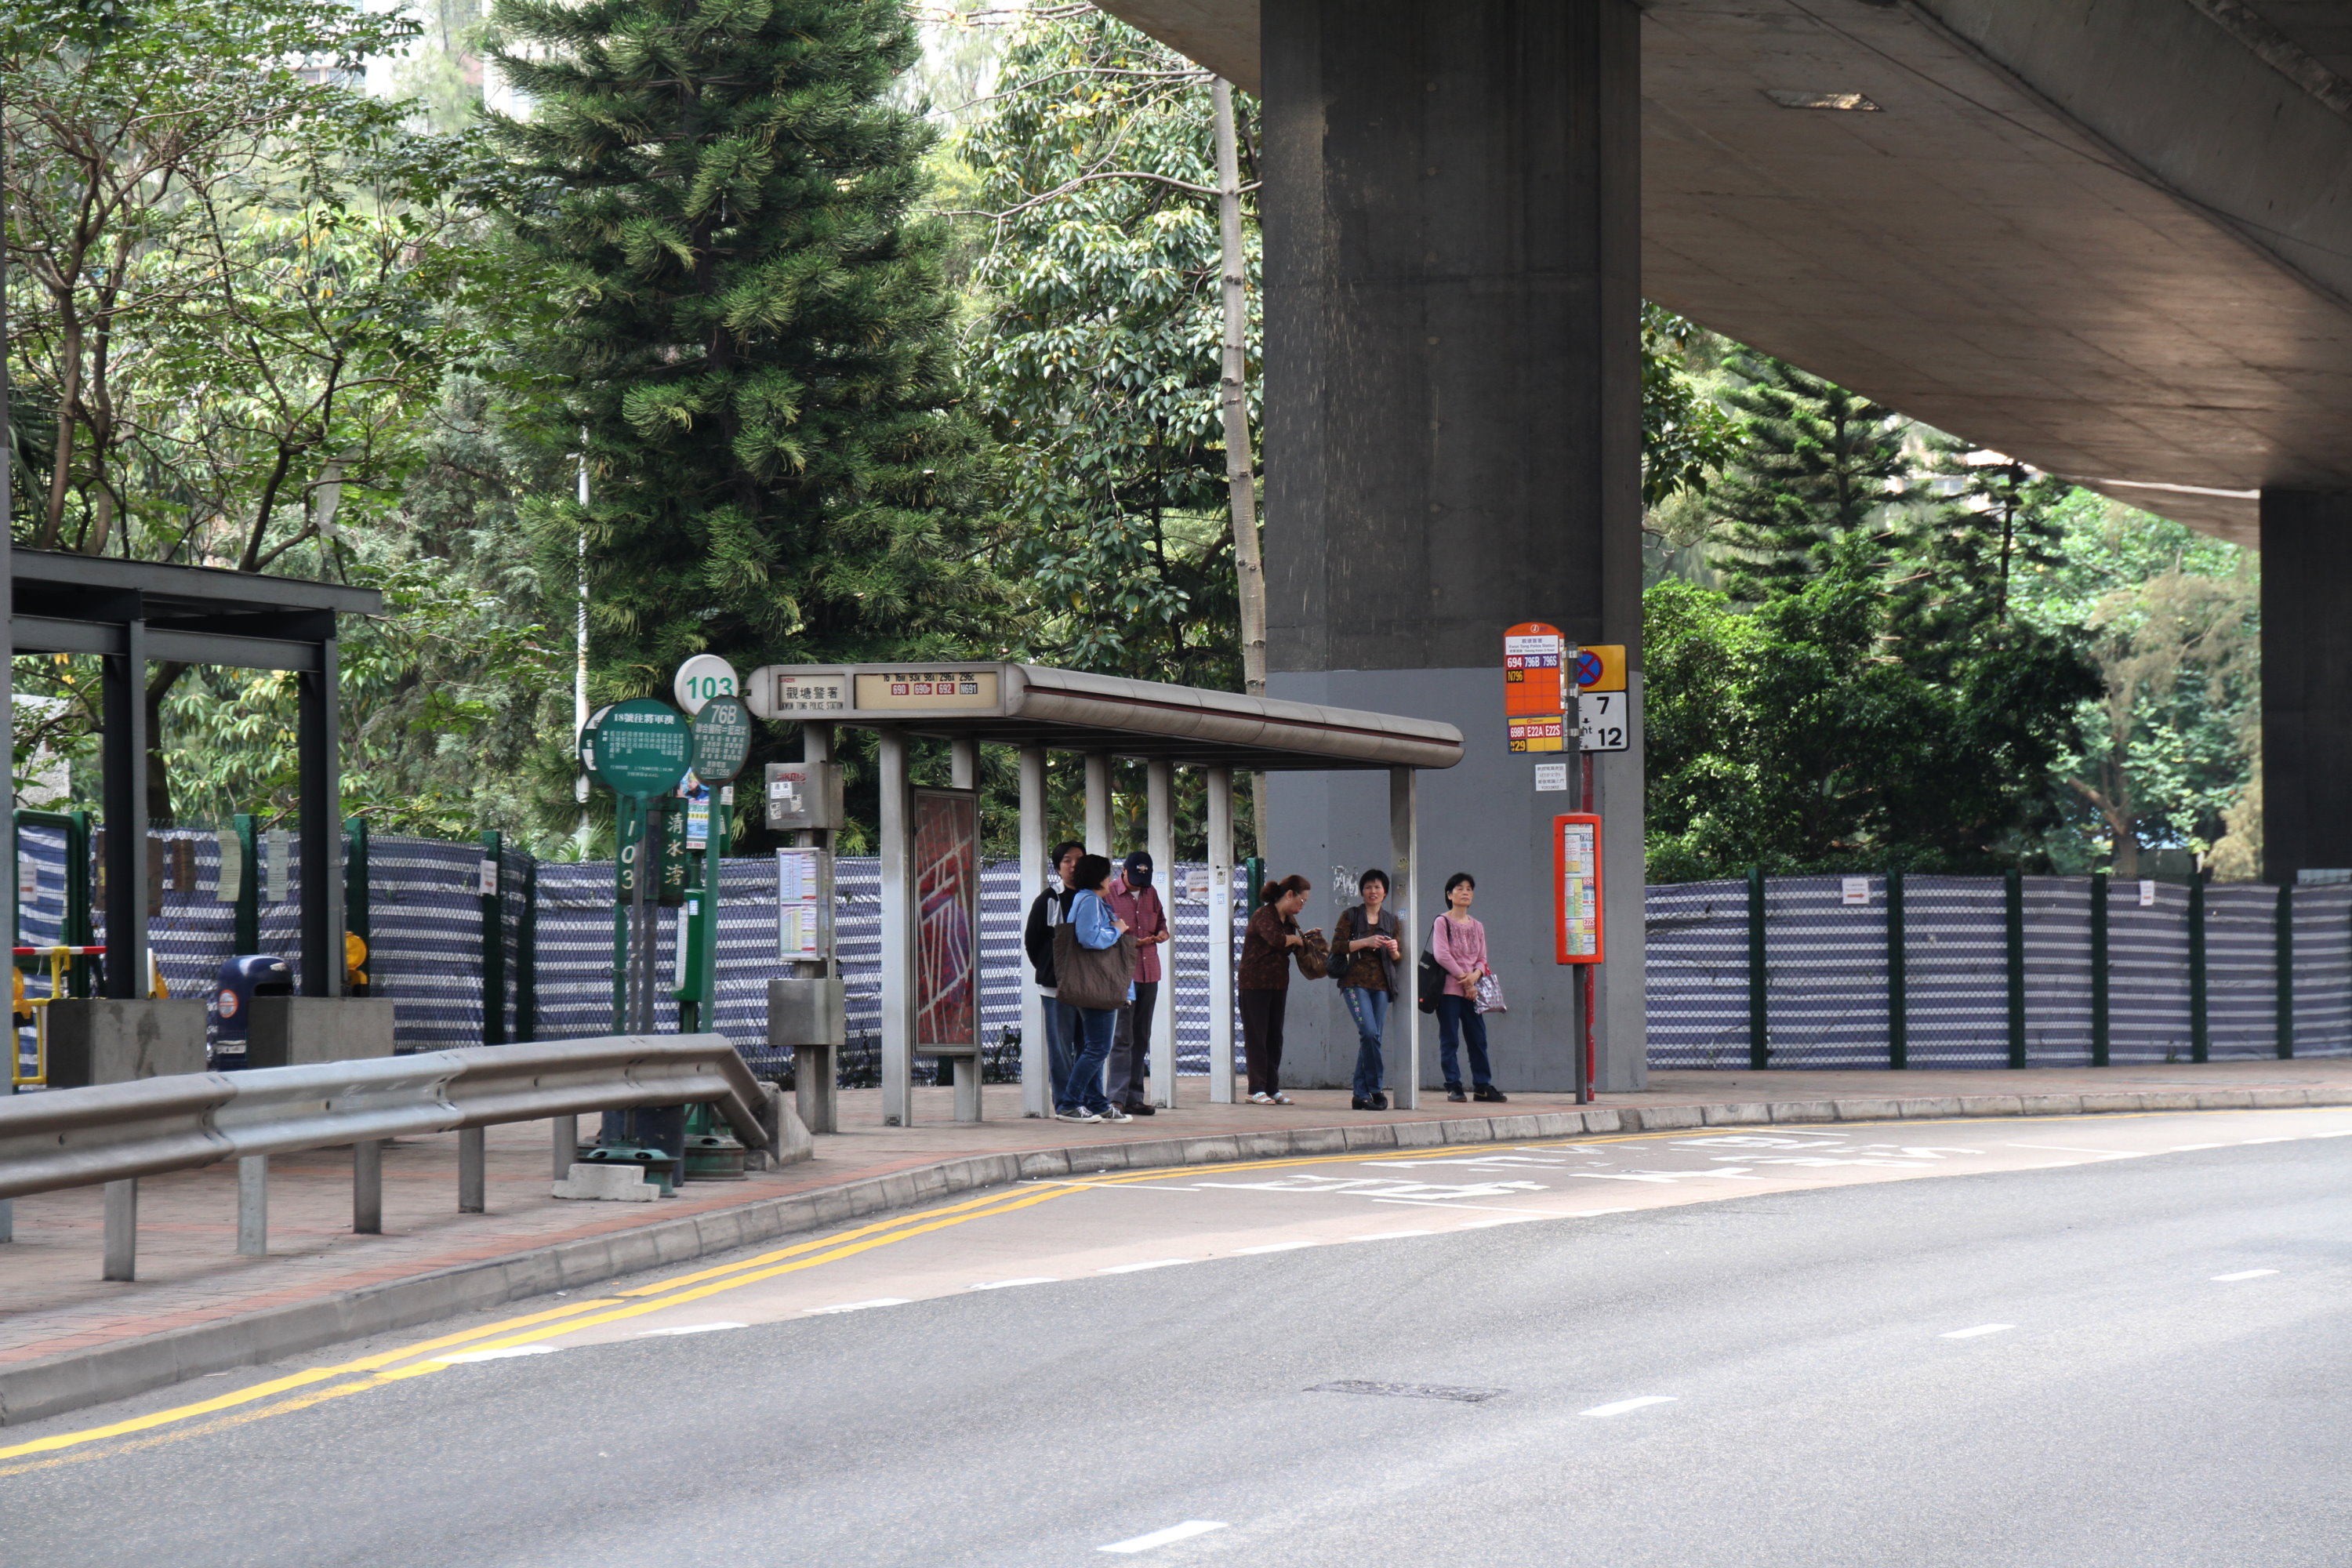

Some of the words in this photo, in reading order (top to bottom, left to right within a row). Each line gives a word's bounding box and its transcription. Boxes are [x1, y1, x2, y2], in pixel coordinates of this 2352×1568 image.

[1507, 657, 1523, 668] 694
[1524, 656, 1540, 667] 796B
[1542, 655, 1557, 666] 796S
[909, 673, 920, 682] 93K
[924, 673, 935, 682] 98A
[940, 673, 954, 682] 296A
[1508, 670, 1523, 681] N796
[686, 677, 733, 699] 103
[786, 687, 838, 699] 觀塘警署
[892, 684, 906, 695] 690
[915, 684, 931, 695] 690P
[938, 684, 952, 694] 692
[960, 684, 977, 695] N691
[810, 702, 824, 710] POLICE
[826, 701, 844, 710] STATION
[1596, 696, 1610, 715] 7
[614, 713, 674, 724] 18號往將軍澳
[711, 705, 737, 724] 76B
[1510, 726, 1525, 738] 698R
[1527, 726, 1543, 737] E22A
[1545, 725, 1560, 736] E22S
[1598, 727, 1622, 746] 12
[621, 820, 636, 890] 103
